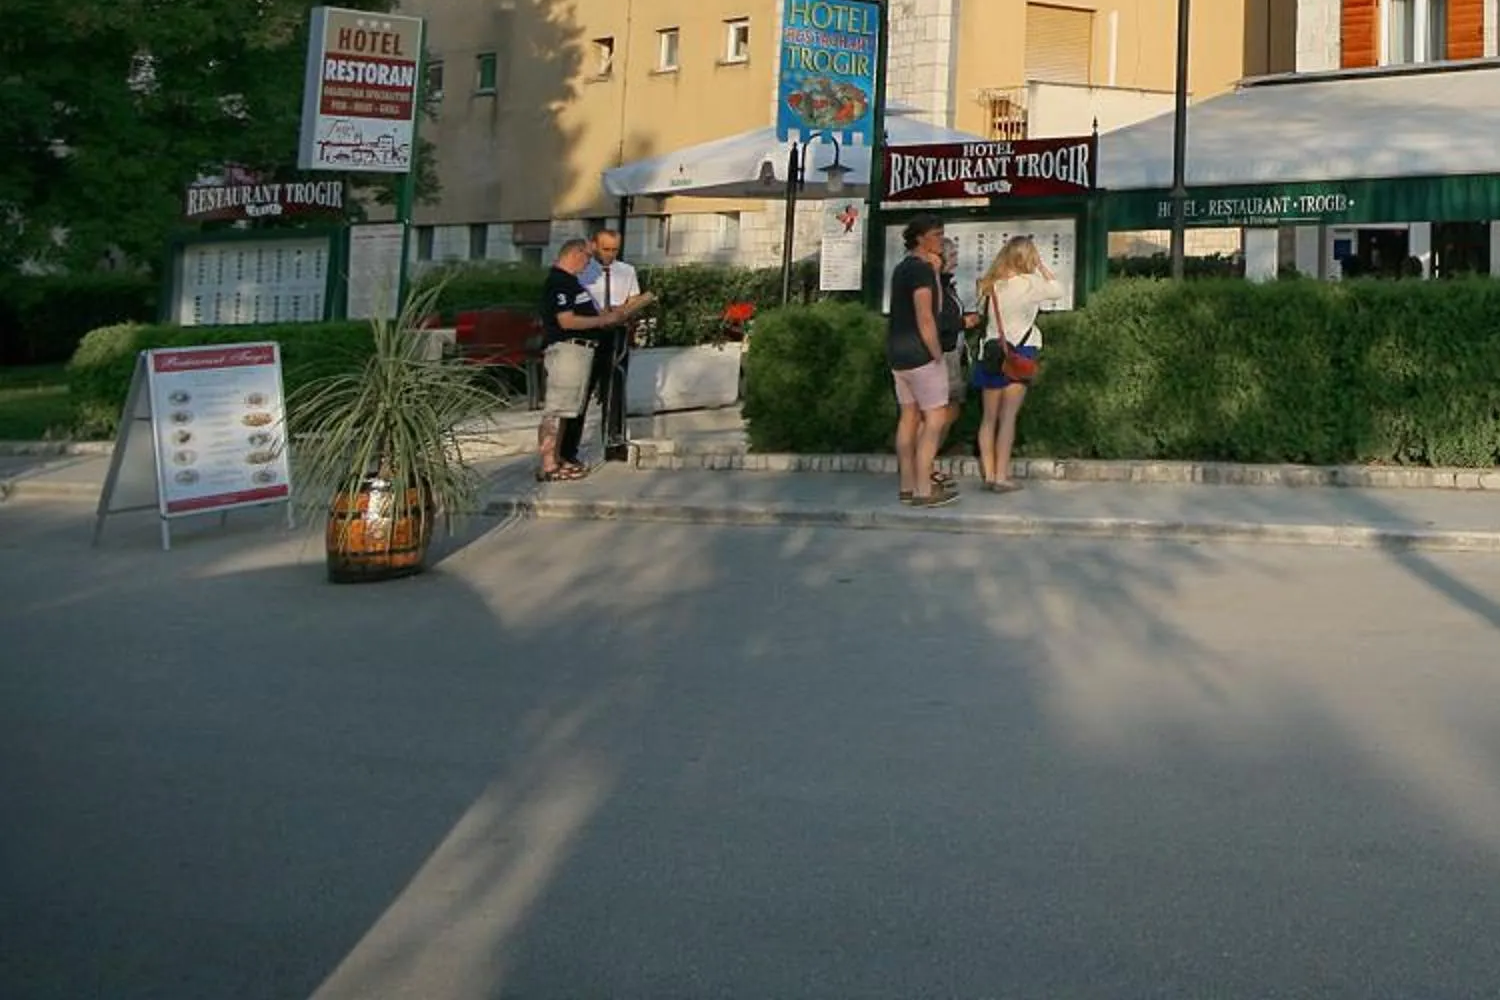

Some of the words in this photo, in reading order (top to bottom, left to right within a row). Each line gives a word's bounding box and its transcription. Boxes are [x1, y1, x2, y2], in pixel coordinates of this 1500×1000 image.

[338, 27, 403, 56] HOTEL
[325, 59, 414, 87] RESTORAN
[788, 46, 869, 76] TROGIR
[963, 142, 1015, 157] HOTEL
[887, 152, 1011, 198] RESTAURANT
[1015, 143, 1090, 187] TROGIR
[187, 183, 281, 216] RESTAURANT
[285, 181, 343, 209] TROGIR
[1158, 200, 1199, 217] HEL
[1208, 196, 1289, 216] RESTAURANT
